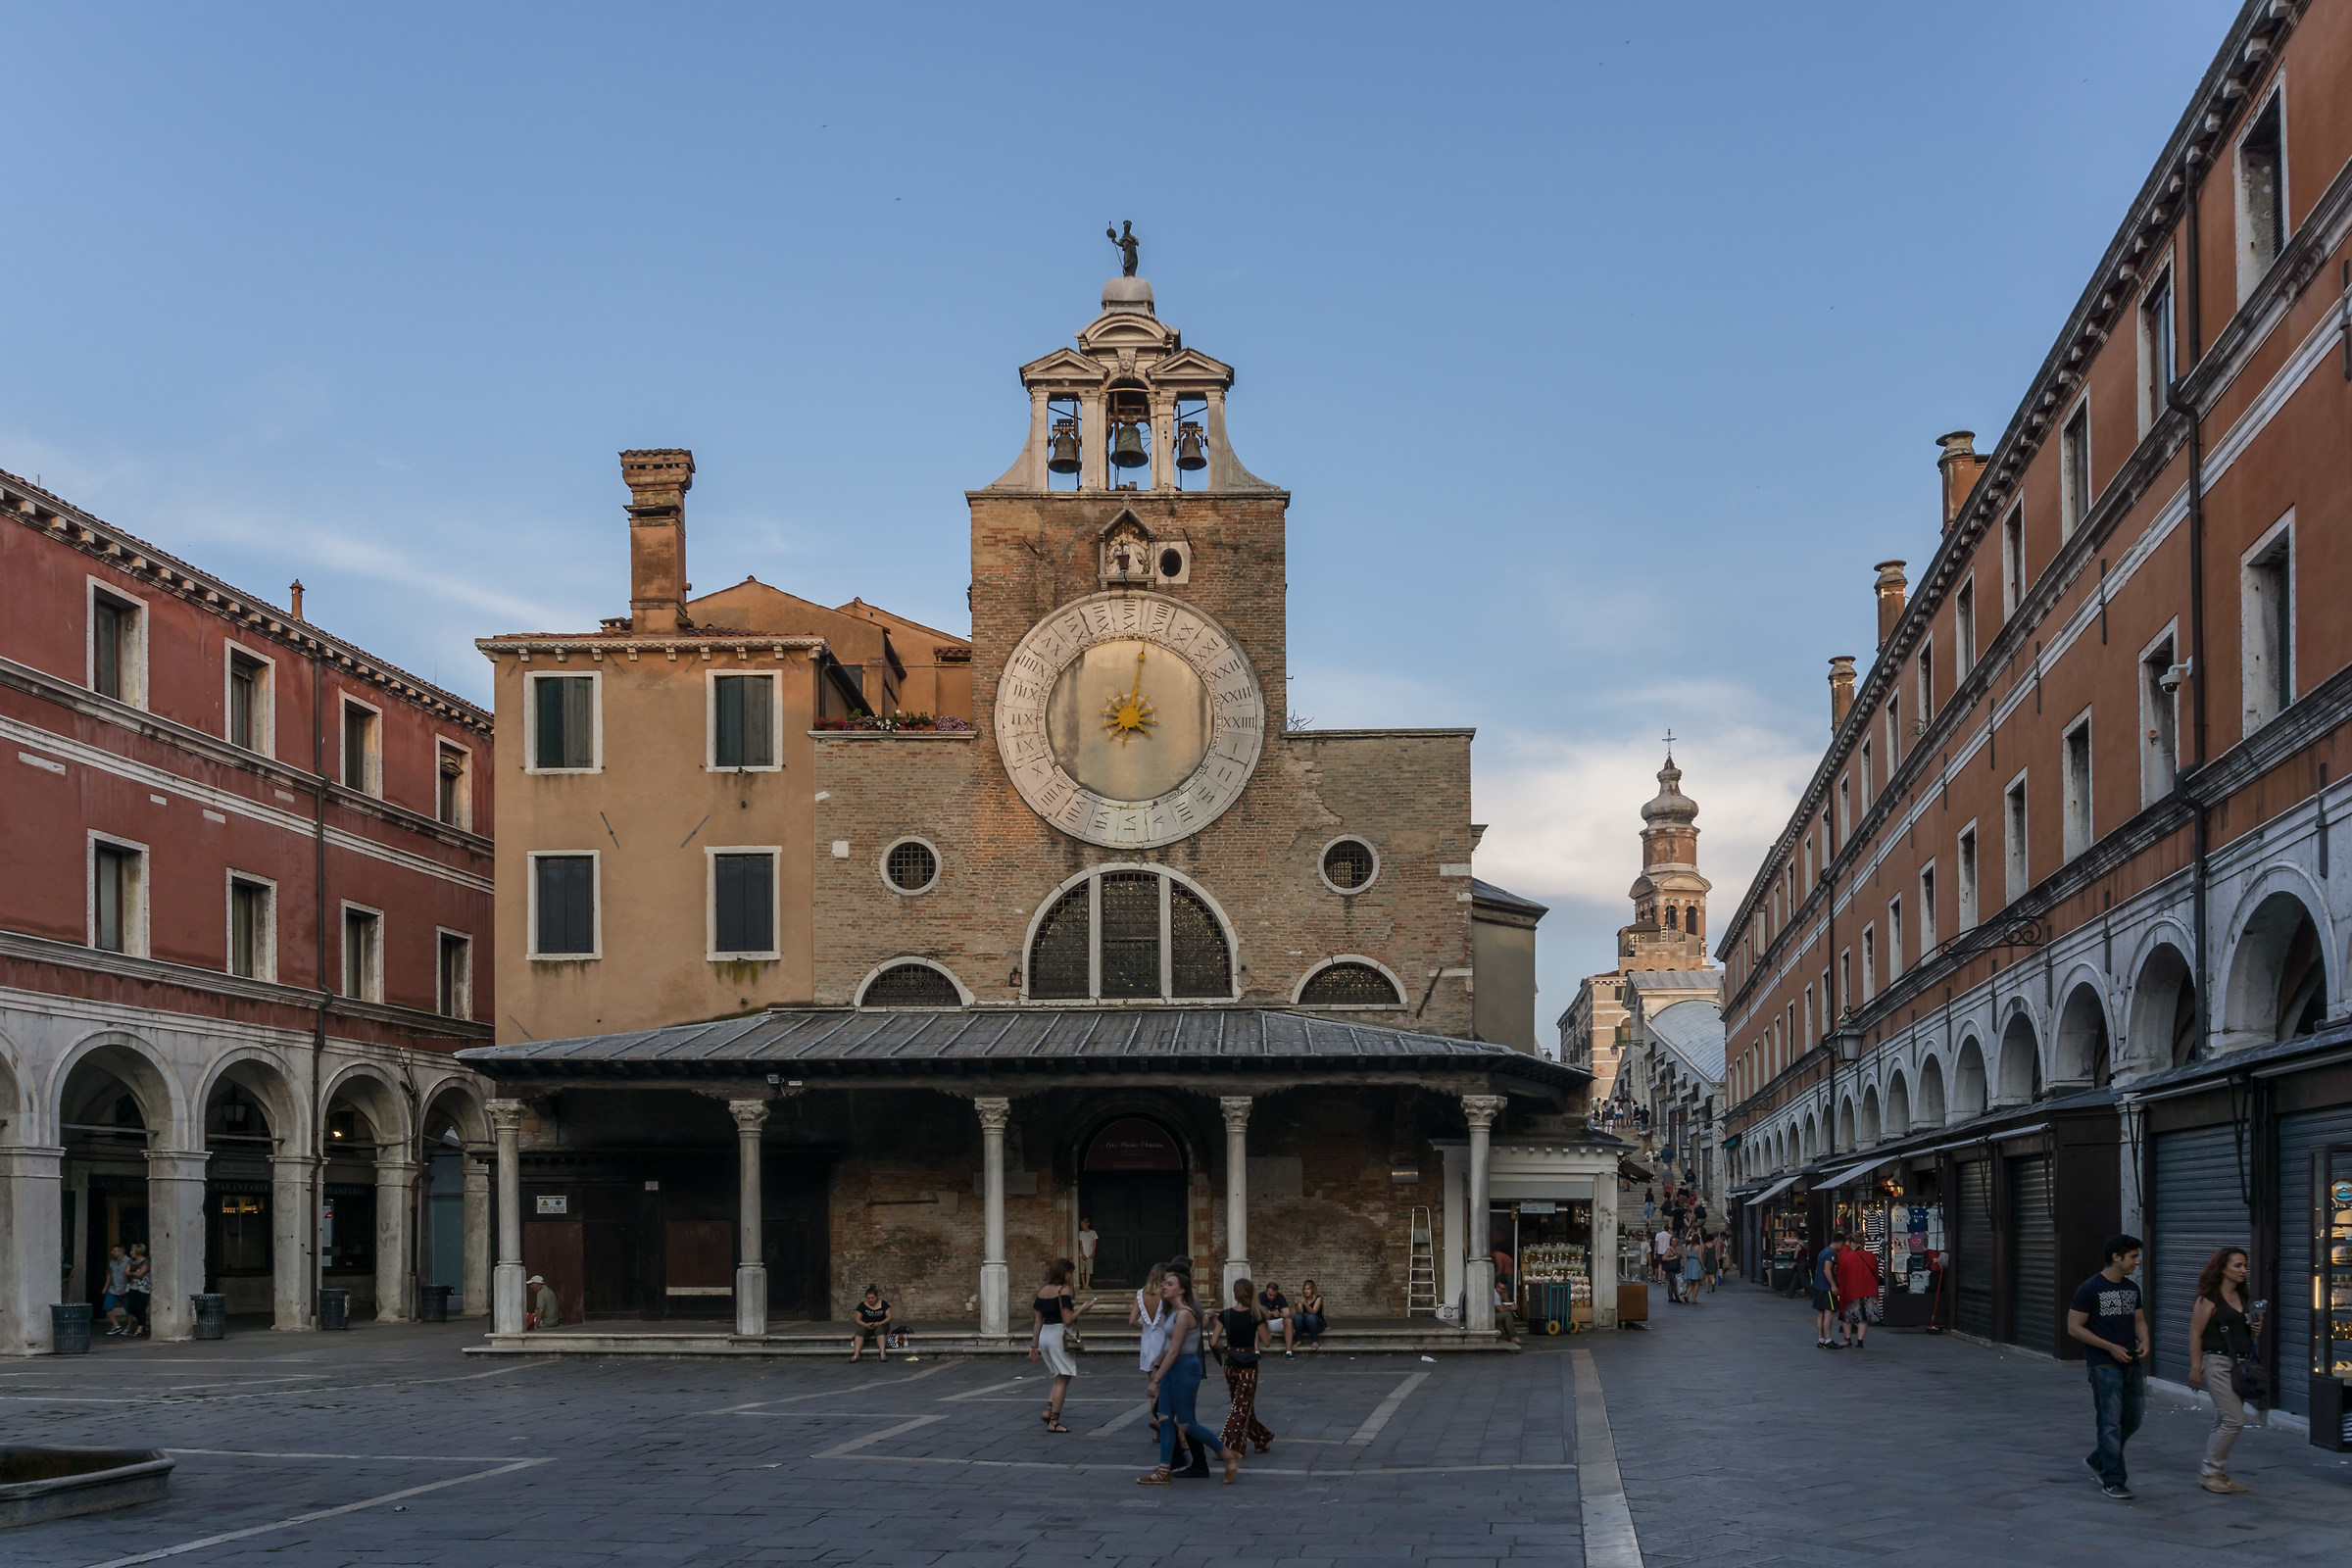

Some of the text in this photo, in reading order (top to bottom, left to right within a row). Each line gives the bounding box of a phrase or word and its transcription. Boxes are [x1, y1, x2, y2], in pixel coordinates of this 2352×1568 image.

[1093, 605, 1110, 633] XVII
[1064, 616, 1087, 643] XVI
[1173, 622, 1195, 646] XX
[1041, 637, 1063, 657] XV
[1194, 637, 1219, 662] XXI
[1019, 655, 1050, 678] XIIII
[1209, 659, 1241, 682] XXII
[1013, 683, 1040, 701] XIII
[1219, 686, 1252, 704] XXIII
[1011, 713, 1033, 725] XII
[1223, 715, 1255, 728] XXIIII
[1015, 738, 1034, 753] XI
[1031, 764, 1044, 778] X
[1040, 783, 1067, 807] VIIII
[1065, 801, 1087, 823] VIII
[1094, 810, 1110, 830] VII
[1123, 814, 1136, 832] VI
[213, 1183, 269, 1193] NARANZARIA
